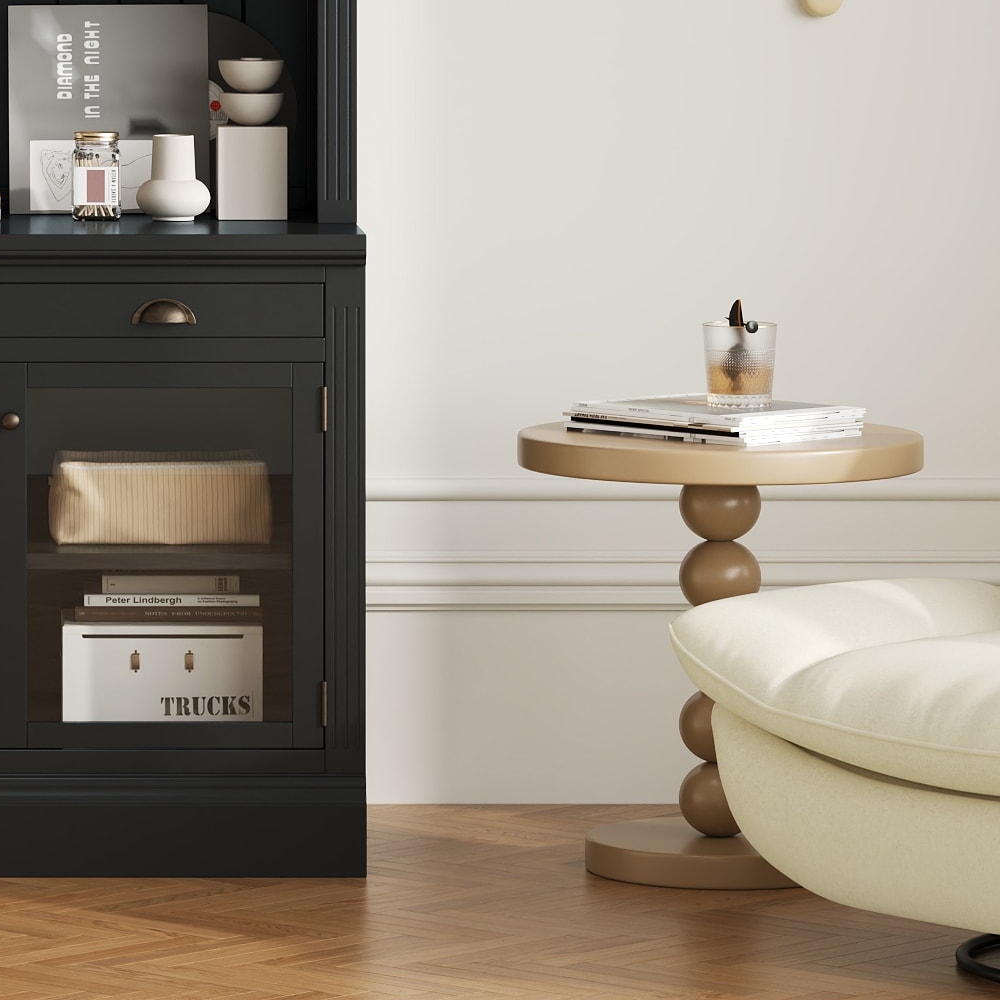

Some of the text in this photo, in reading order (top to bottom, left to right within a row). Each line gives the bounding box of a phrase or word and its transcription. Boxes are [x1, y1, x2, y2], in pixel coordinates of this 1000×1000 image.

[57, 33, 72, 99] DIAMOND
[84, 21, 100, 118] IN THE NIGHT
[105, 596, 182, 606] Peter Lindbergh
[160, 696, 251, 716] TRUCKS
